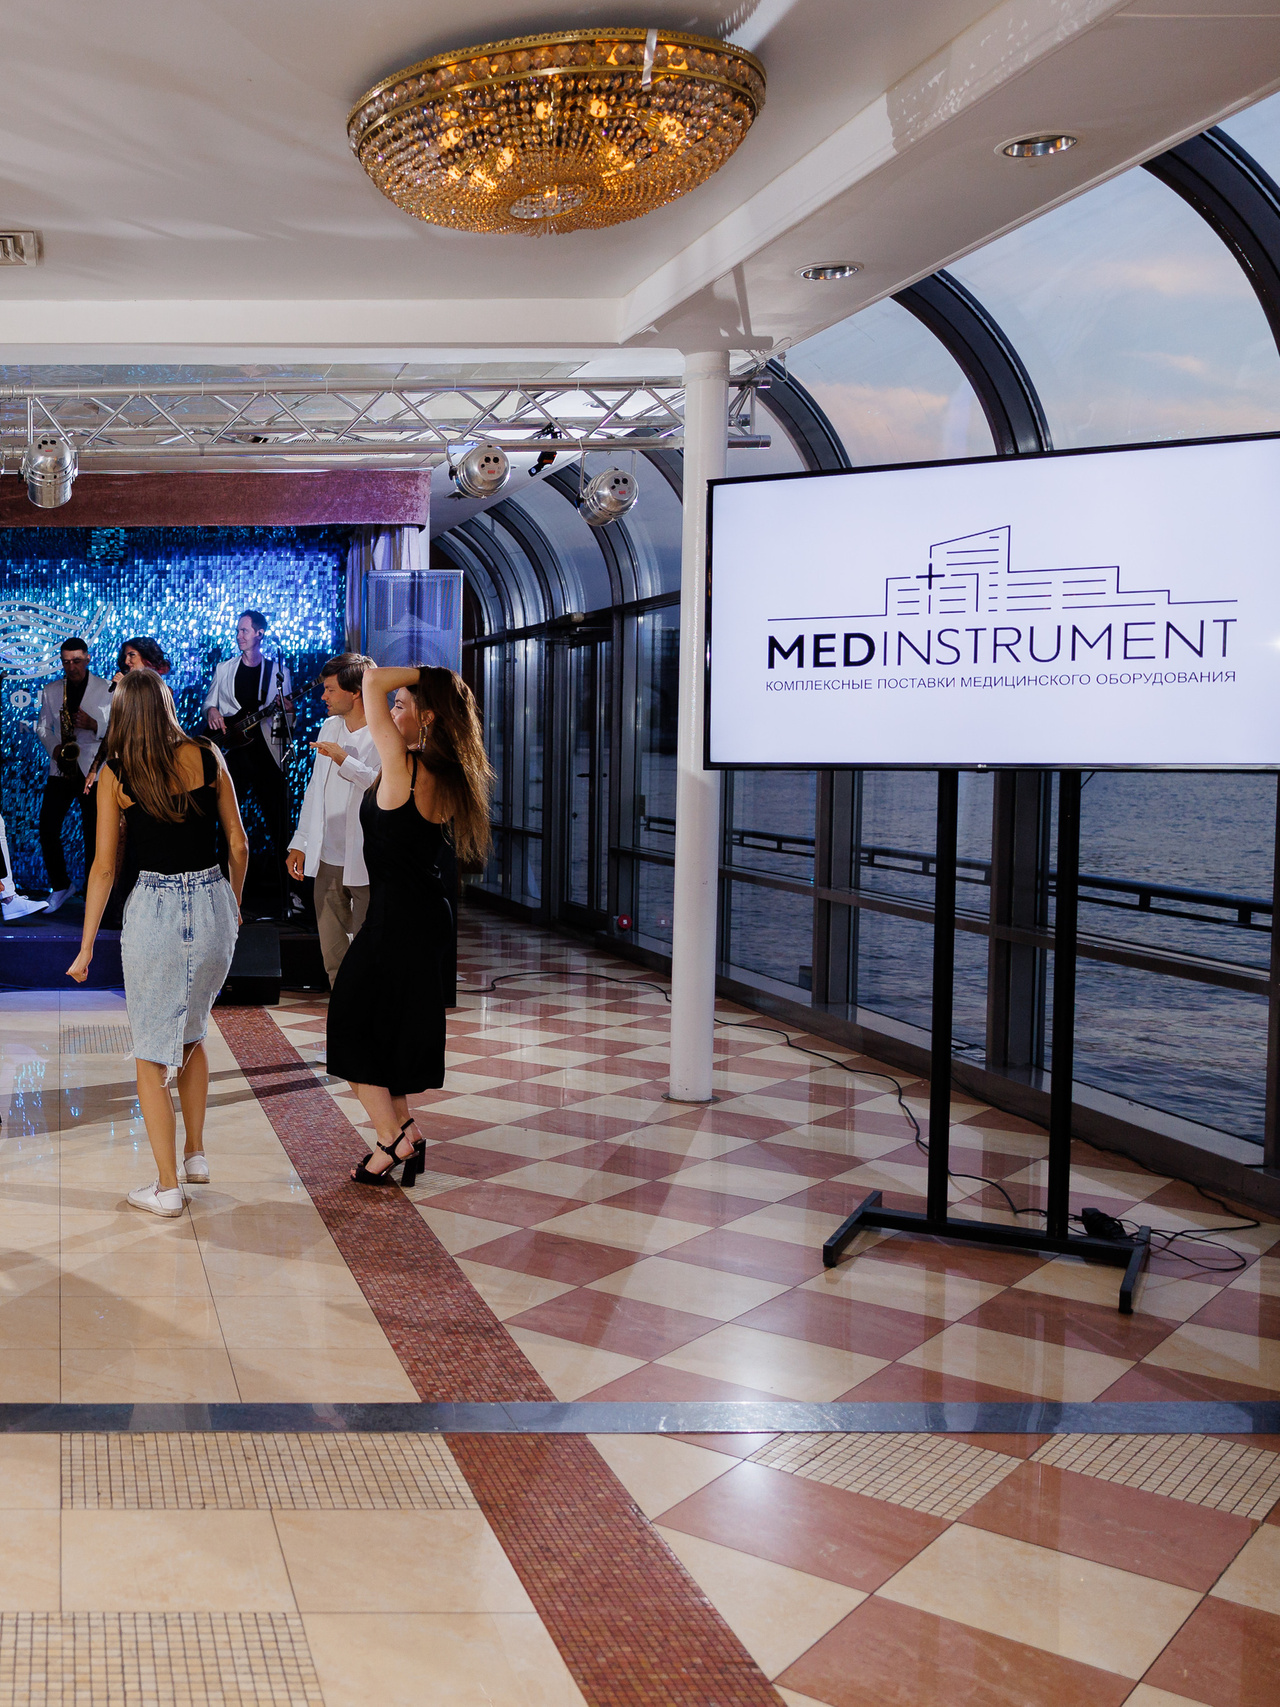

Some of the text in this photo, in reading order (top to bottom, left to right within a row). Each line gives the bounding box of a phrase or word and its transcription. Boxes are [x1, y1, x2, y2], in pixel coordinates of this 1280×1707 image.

[767, 618, 1238, 670] MEDINSTRUMENT
[765, 670, 1236, 692] КОМПЛЕКСНЫЕ ПОСТАВКИ МЕДИЦИНСКОГО ОБОРУДОВАНИЯ
